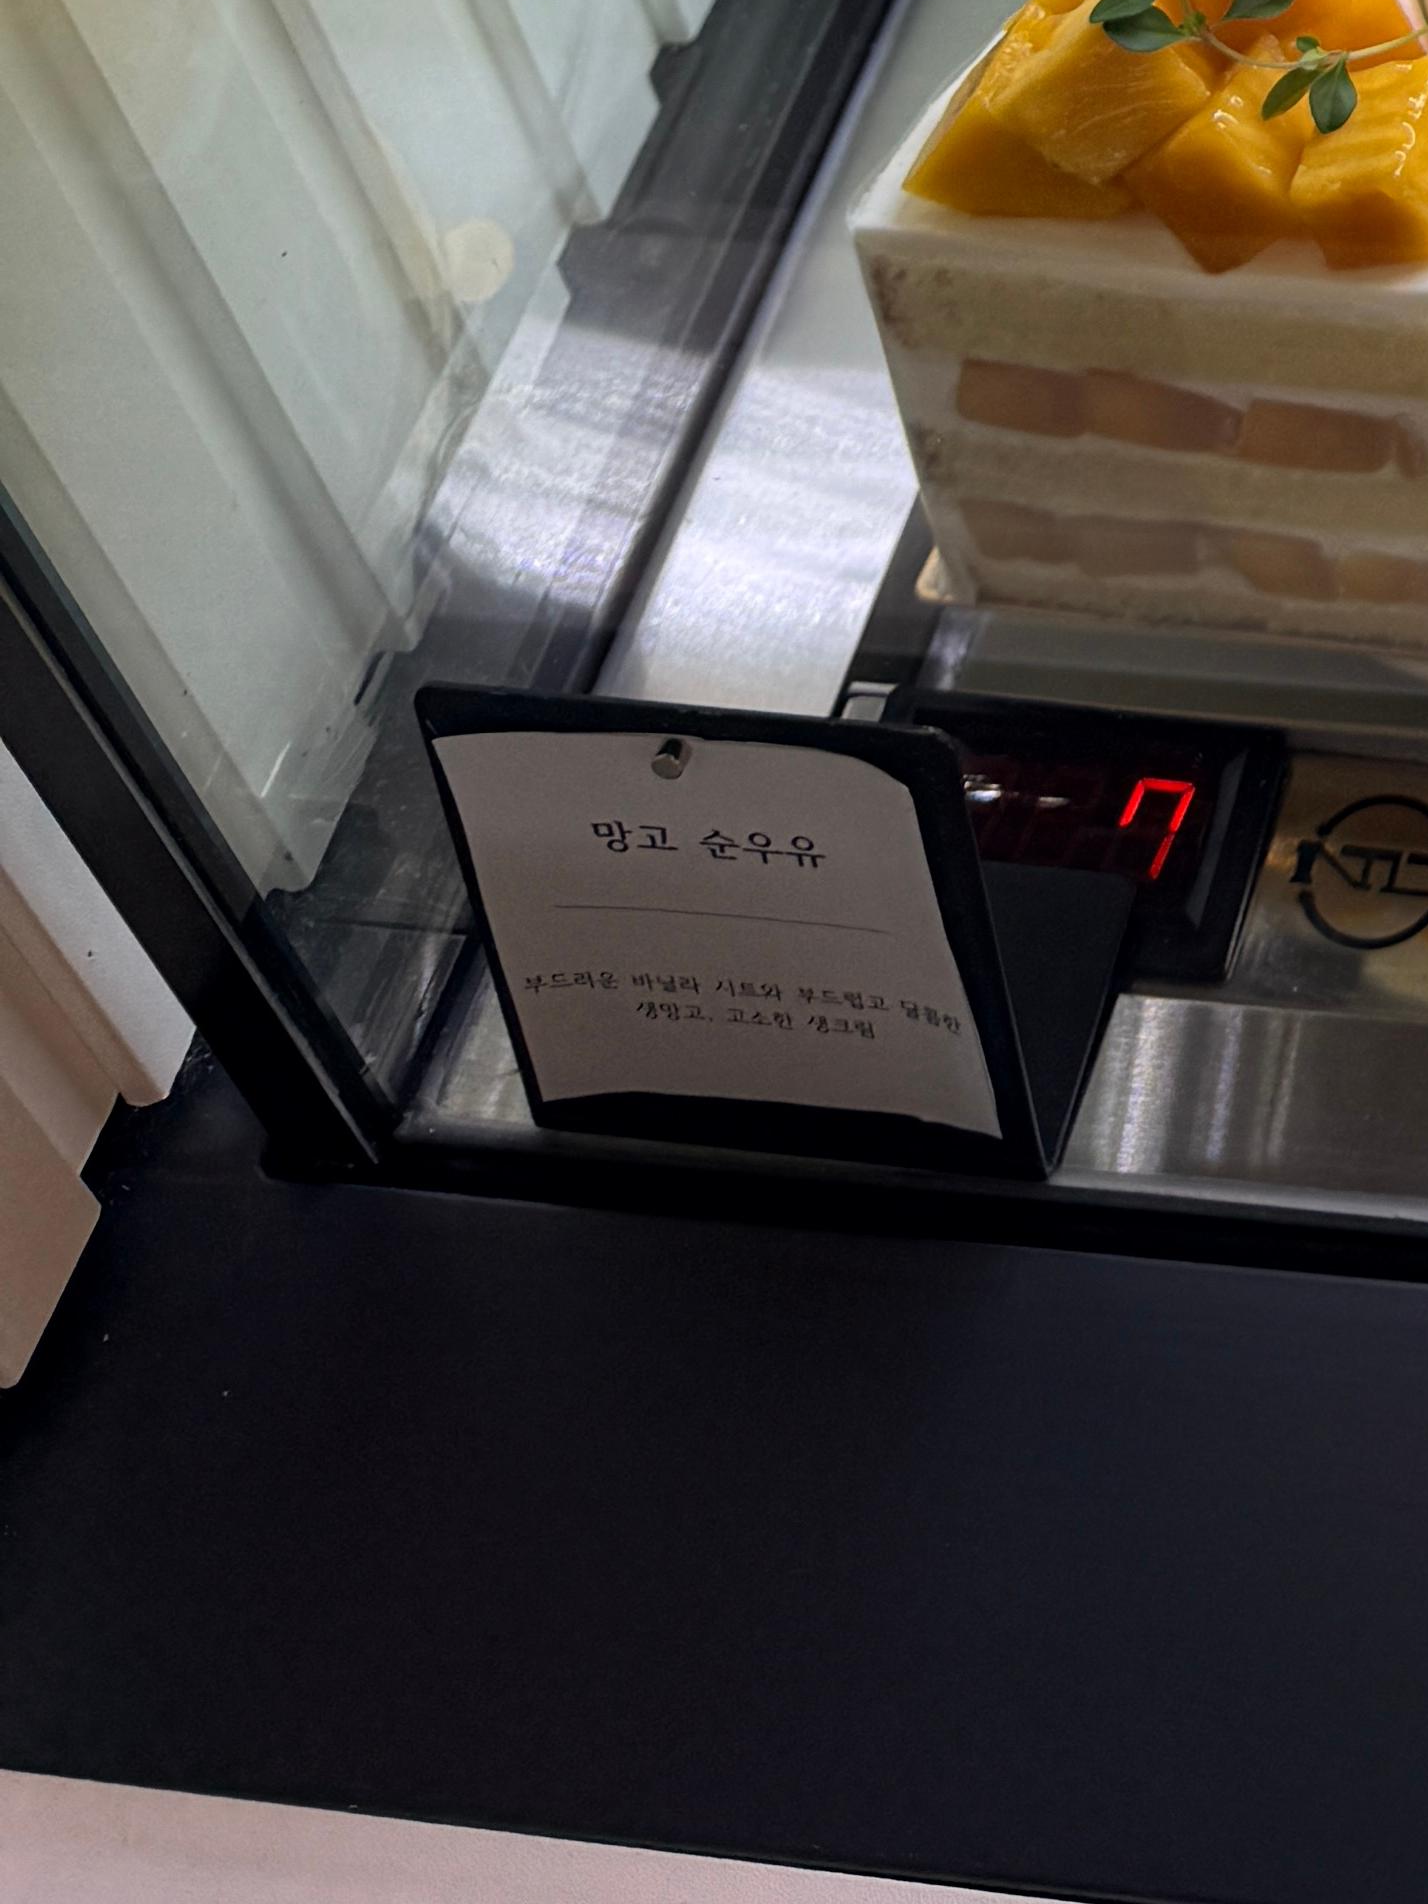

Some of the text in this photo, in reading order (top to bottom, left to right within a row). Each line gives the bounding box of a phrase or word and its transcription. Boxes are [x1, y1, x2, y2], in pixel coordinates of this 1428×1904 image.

[590, 820, 826, 869] 망고 순우유
[1119, 777, 1196, 879] 7
[524, 970, 619, 995] 부드러운
[631, 972, 701, 995] 바닐라
[715, 979, 783, 1002] 시트와
[726, 1007, 794, 1031] 고소한
[807, 1015, 876, 1040] 생크림
